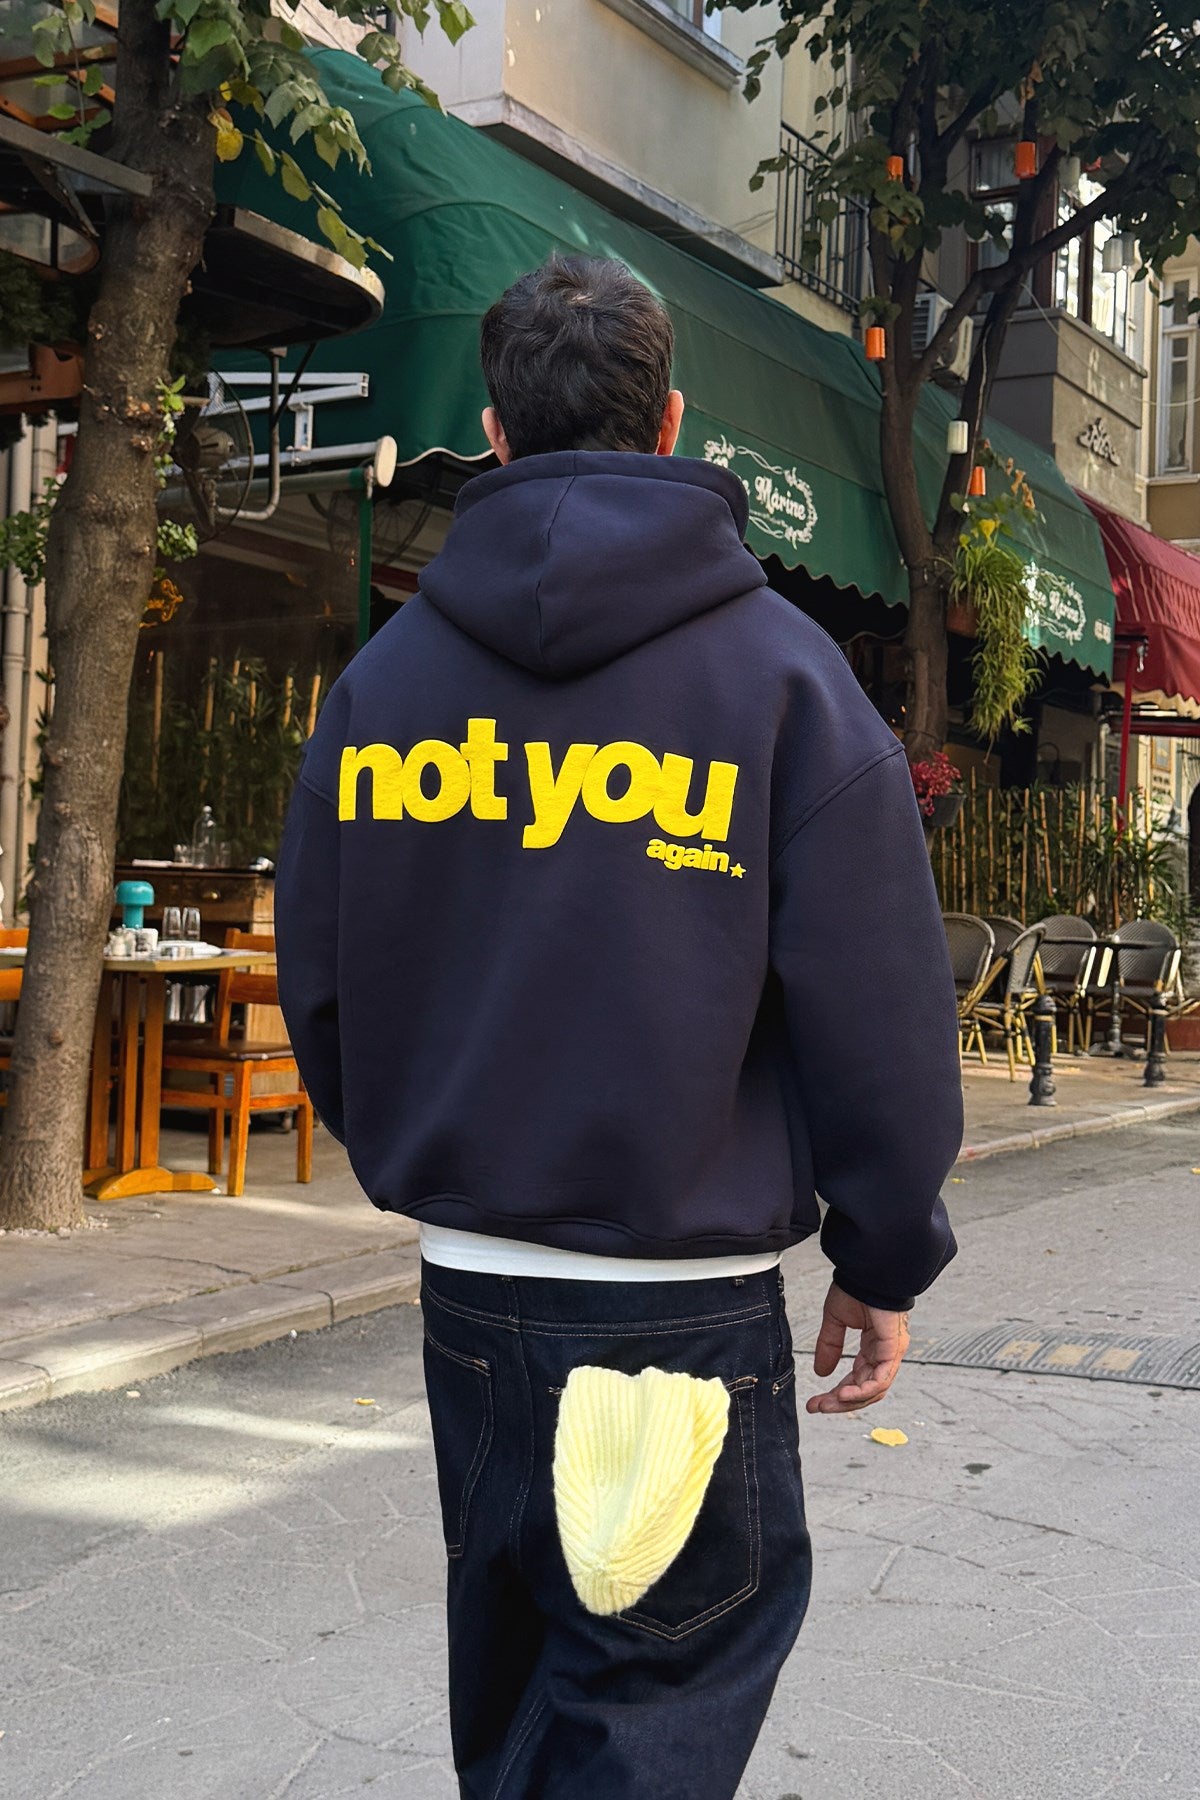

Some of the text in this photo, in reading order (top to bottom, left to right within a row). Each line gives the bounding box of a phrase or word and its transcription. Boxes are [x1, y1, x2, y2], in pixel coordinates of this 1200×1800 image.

[754, 475, 807, 521] Marine
[338, 717, 739, 849] not you
[645, 838, 730, 873] again
